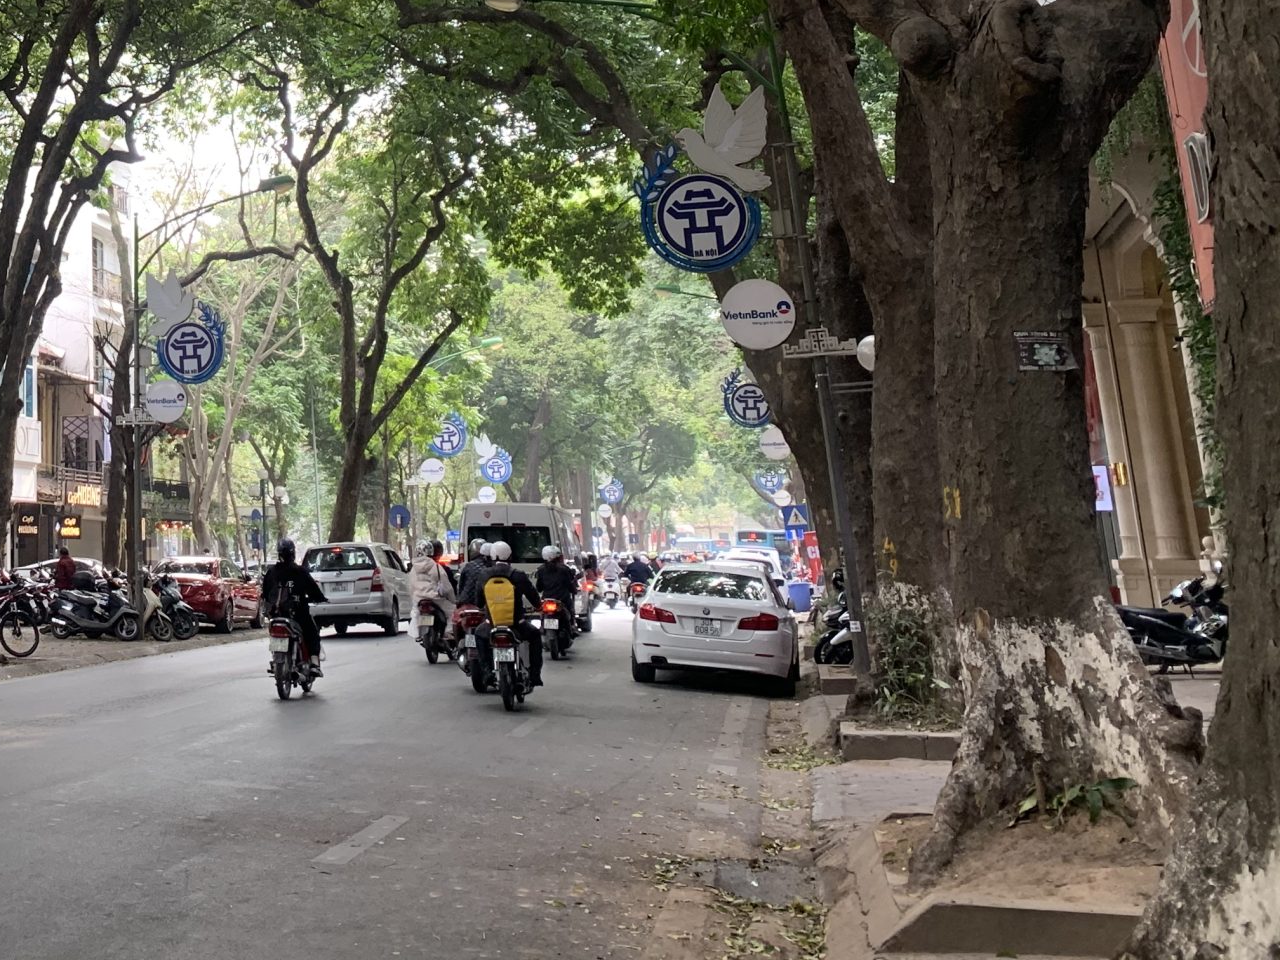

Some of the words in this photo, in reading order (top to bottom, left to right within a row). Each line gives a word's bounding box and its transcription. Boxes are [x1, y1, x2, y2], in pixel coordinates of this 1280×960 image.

[694, 249, 704, 257] HÀ
[705, 248, 717, 257] NỘI
[722, 308, 778, 320] VietinBank
